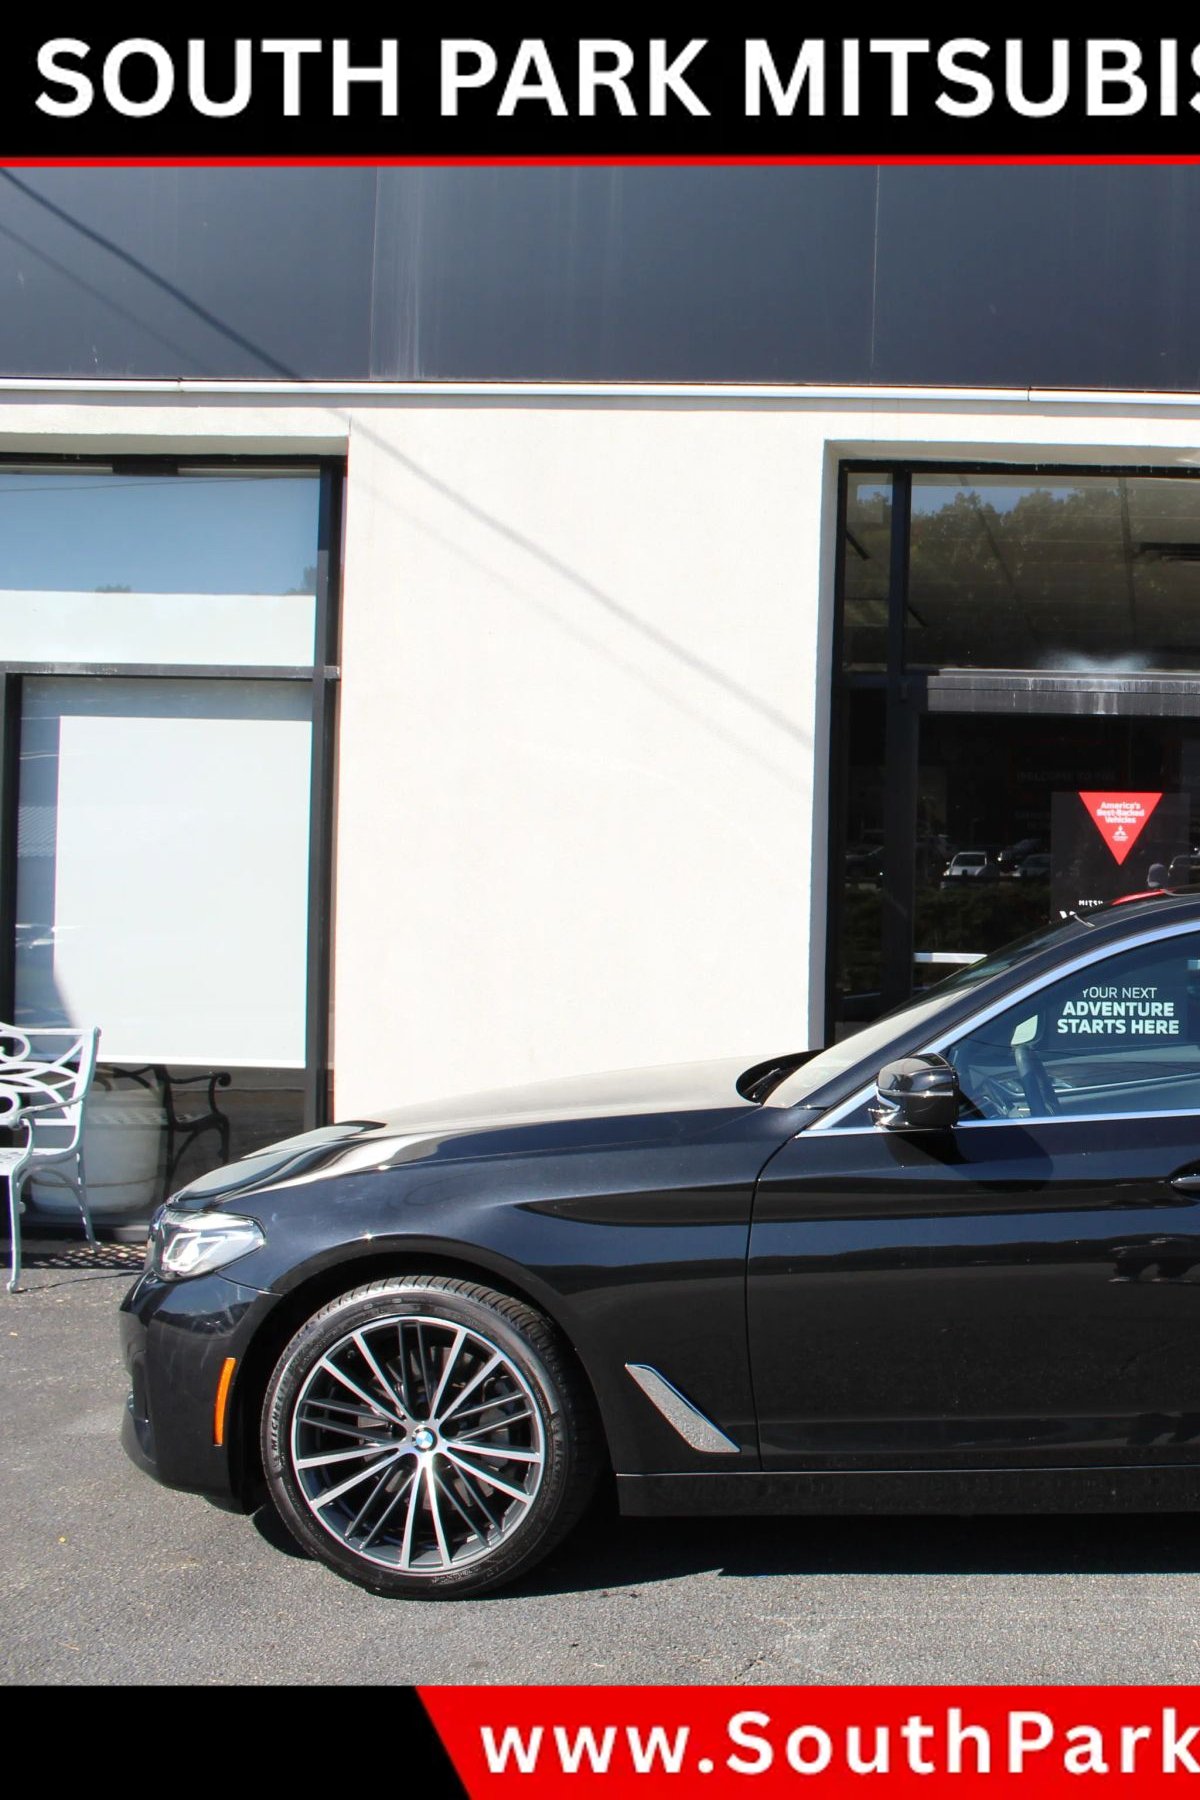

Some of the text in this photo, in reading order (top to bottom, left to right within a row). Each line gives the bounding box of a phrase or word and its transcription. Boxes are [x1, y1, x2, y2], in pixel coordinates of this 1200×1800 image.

[1082, 986, 1158, 999] YOUR NEXT
[1062, 1001, 1175, 1017] ADVENTURE
[1057, 1018, 1180, 1034] STARTS HERE
